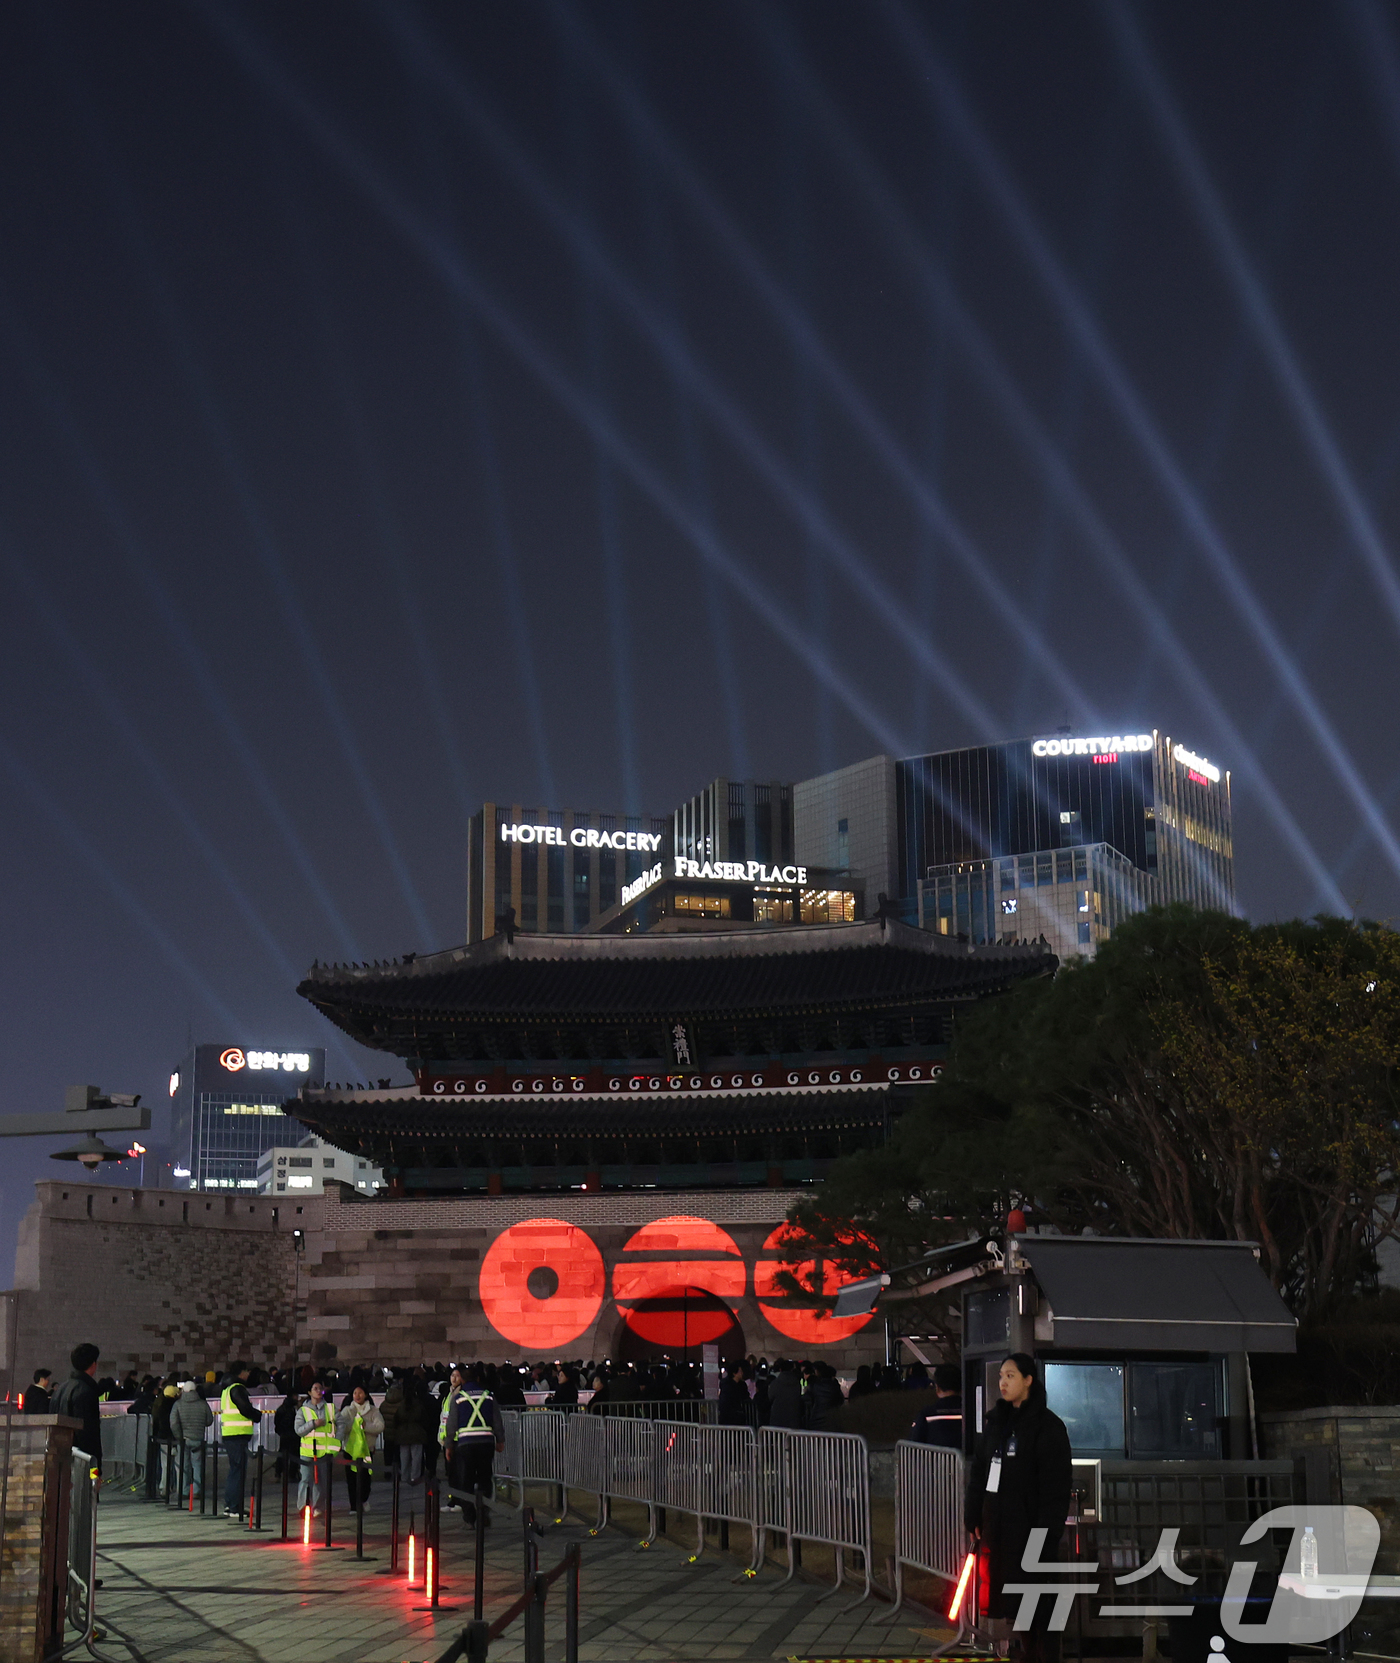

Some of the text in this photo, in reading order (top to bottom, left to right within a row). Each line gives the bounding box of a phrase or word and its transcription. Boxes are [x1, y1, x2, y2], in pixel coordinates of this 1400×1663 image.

[1032, 734, 1153, 757] COURTYARD
[501, 823, 662, 852] HOTEL GRACERY
[246, 1050, 310, 1072] 한화생명
